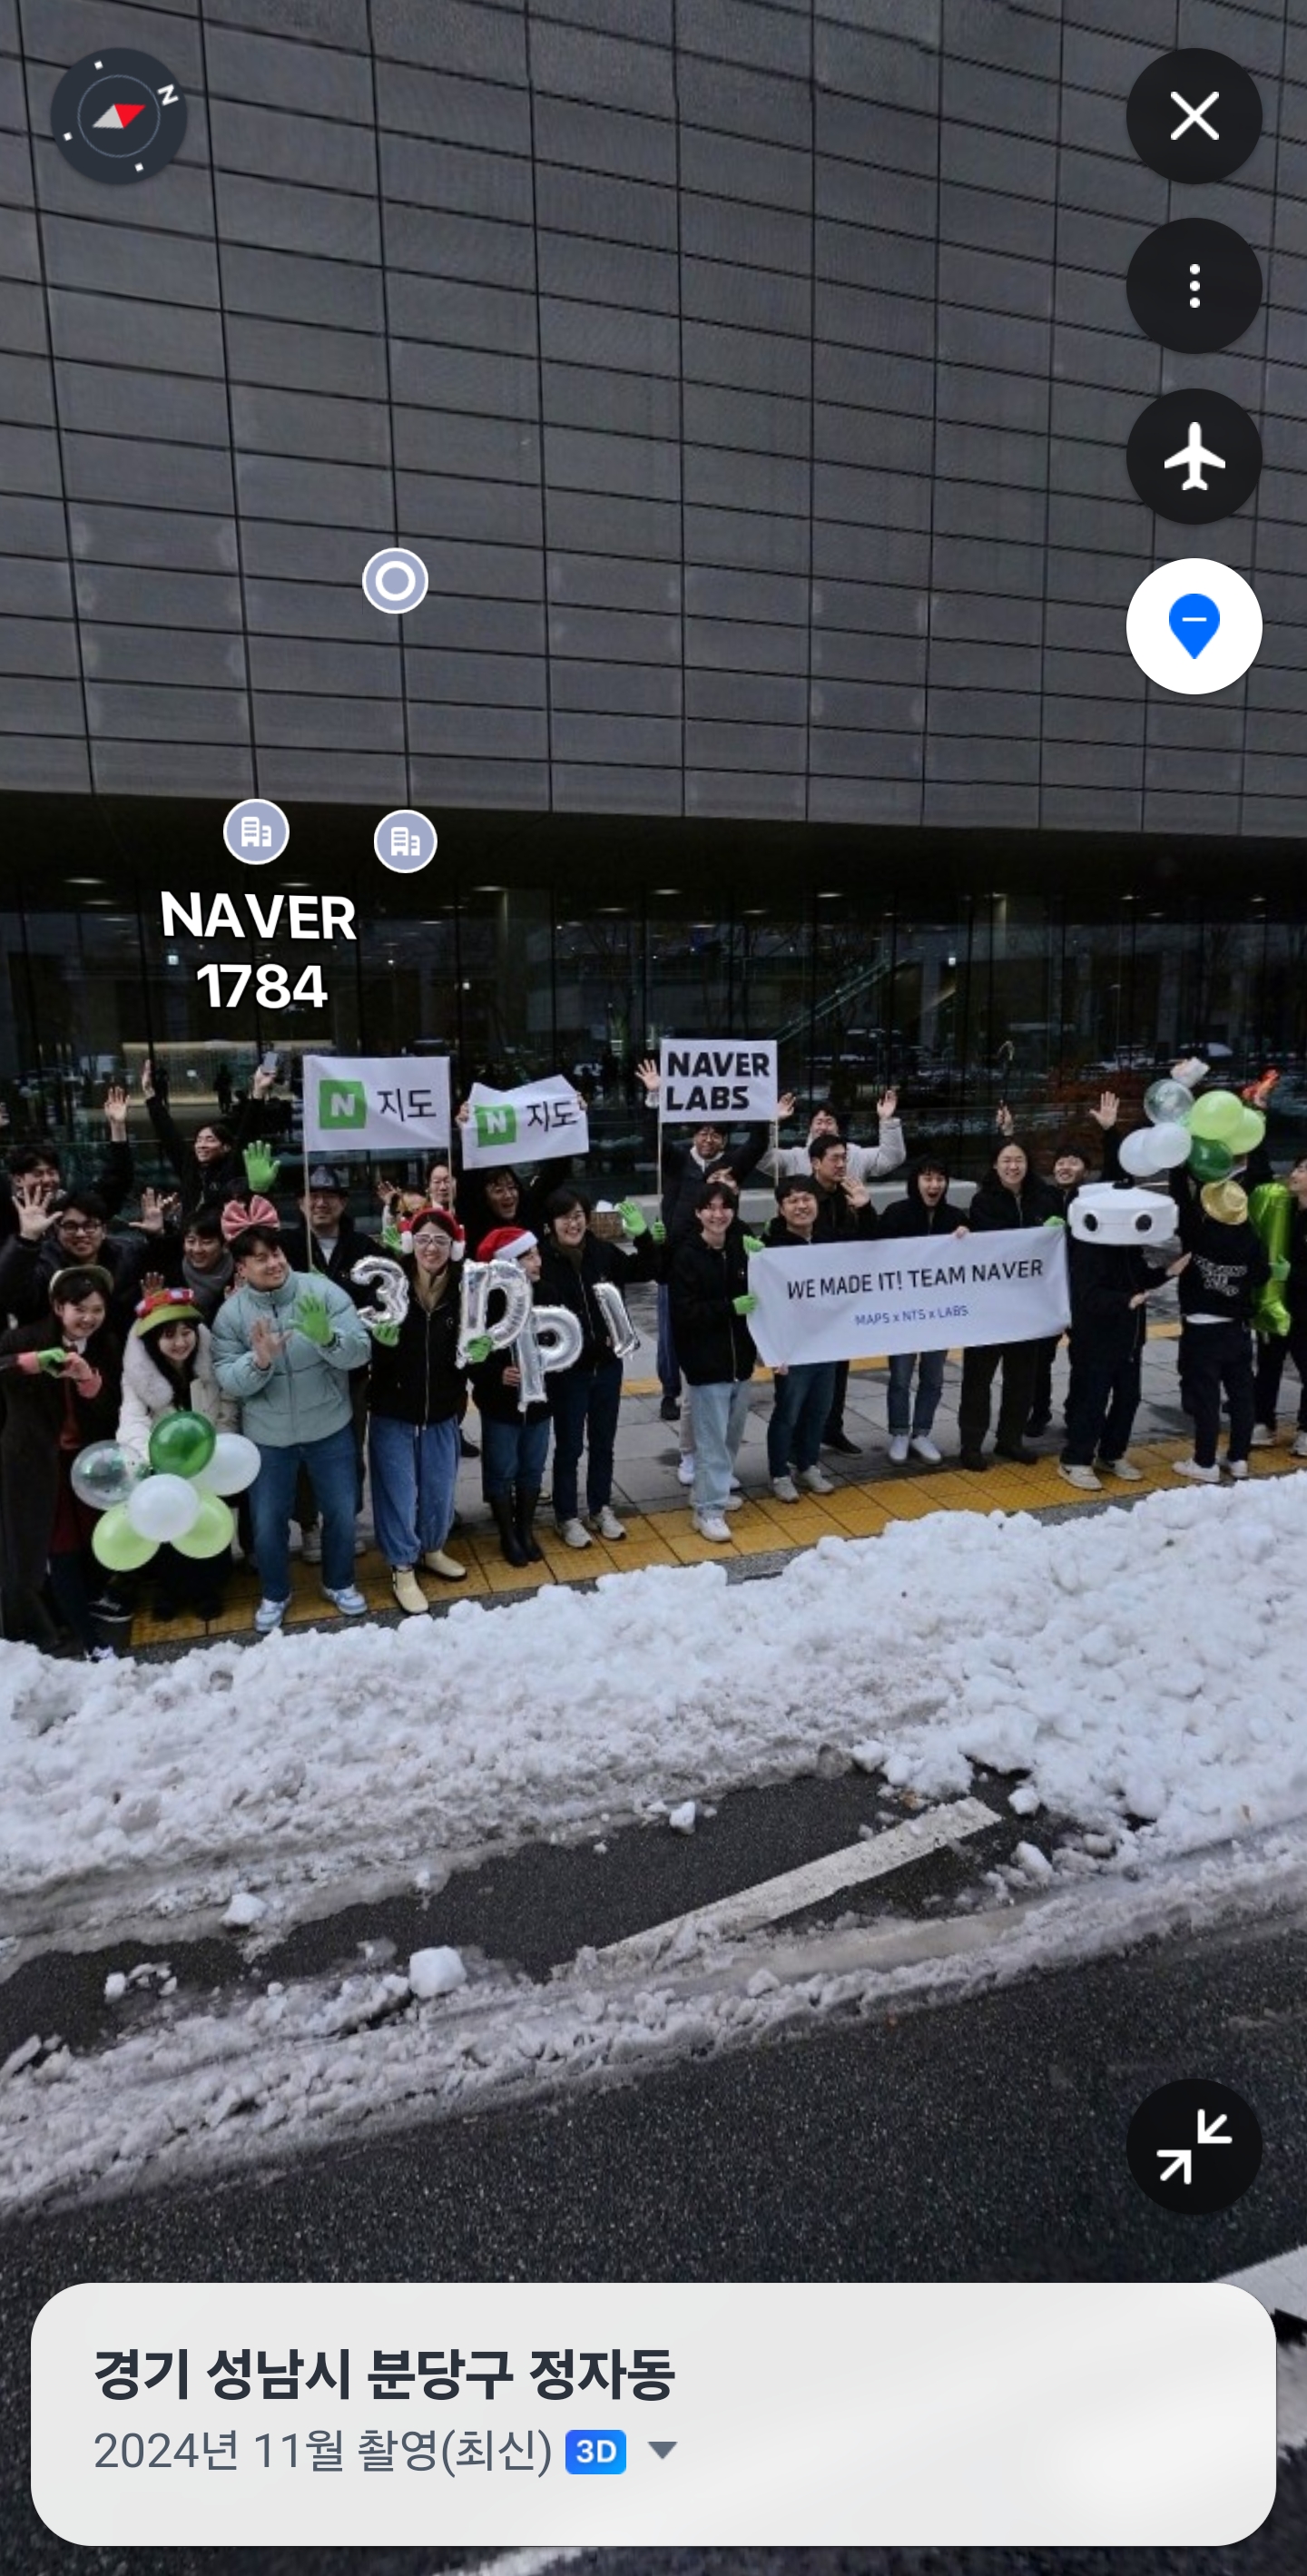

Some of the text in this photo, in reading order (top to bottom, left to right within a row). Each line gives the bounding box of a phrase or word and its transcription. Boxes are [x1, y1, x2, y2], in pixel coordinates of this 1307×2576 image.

[668, 1051, 770, 1077] NAVER
[330, 1087, 437, 1122] N 지도
[666, 1086, 750, 1111] LABS
[487, 1100, 577, 1134] N 지도
[787, 1259, 1044, 1300] WE MADE IT! TEAM NAVER
[855, 1305, 968, 1326] MAPS x NTS x LABS
